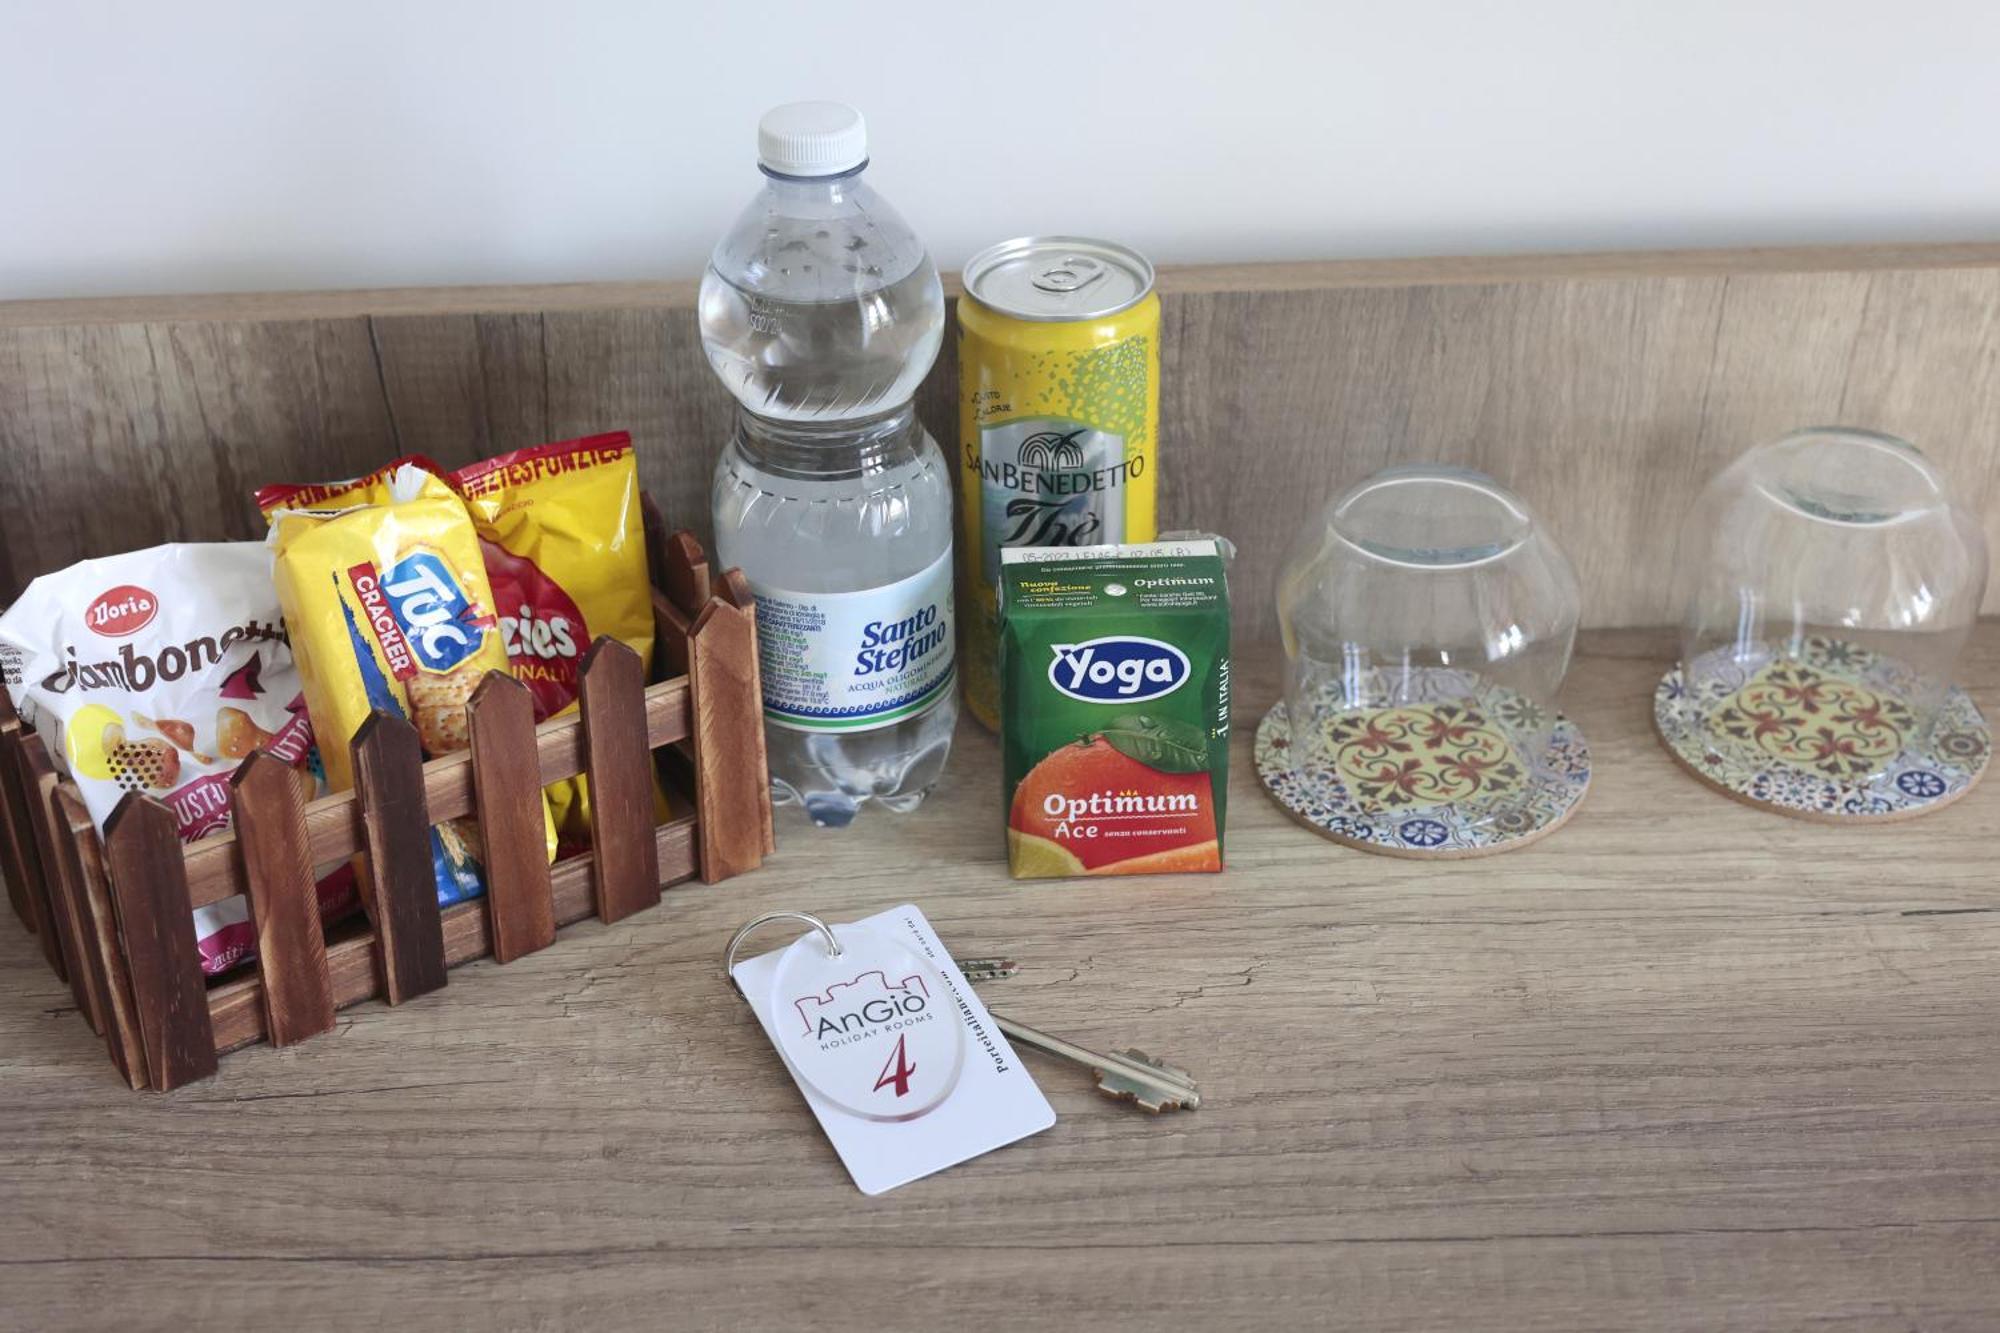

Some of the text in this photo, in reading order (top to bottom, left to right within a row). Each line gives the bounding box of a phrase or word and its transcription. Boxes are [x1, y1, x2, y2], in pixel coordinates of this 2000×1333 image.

[966, 444, 1145, 496] SAN BENEDETTO
[1134, 578, 1215, 589] Optimum
[93, 596, 151, 625] Doria
[356, 576, 410, 672] CRACKER
[500, 604, 577, 659] zies
[861, 604, 937, 649] Santo
[854, 621, 946, 675] Stefano
[512, 664, 565, 682] INALI
[848, 680, 885, 693] ACQUA
[1063, 649, 1173, 695] Yoga
[1043, 791, 1198, 822] Optimum
[1054, 822, 1098, 839] Ace
[820, 1012, 934, 1051] HOLIDAY ROOMS
[872, 1033, 916, 1098] 4
